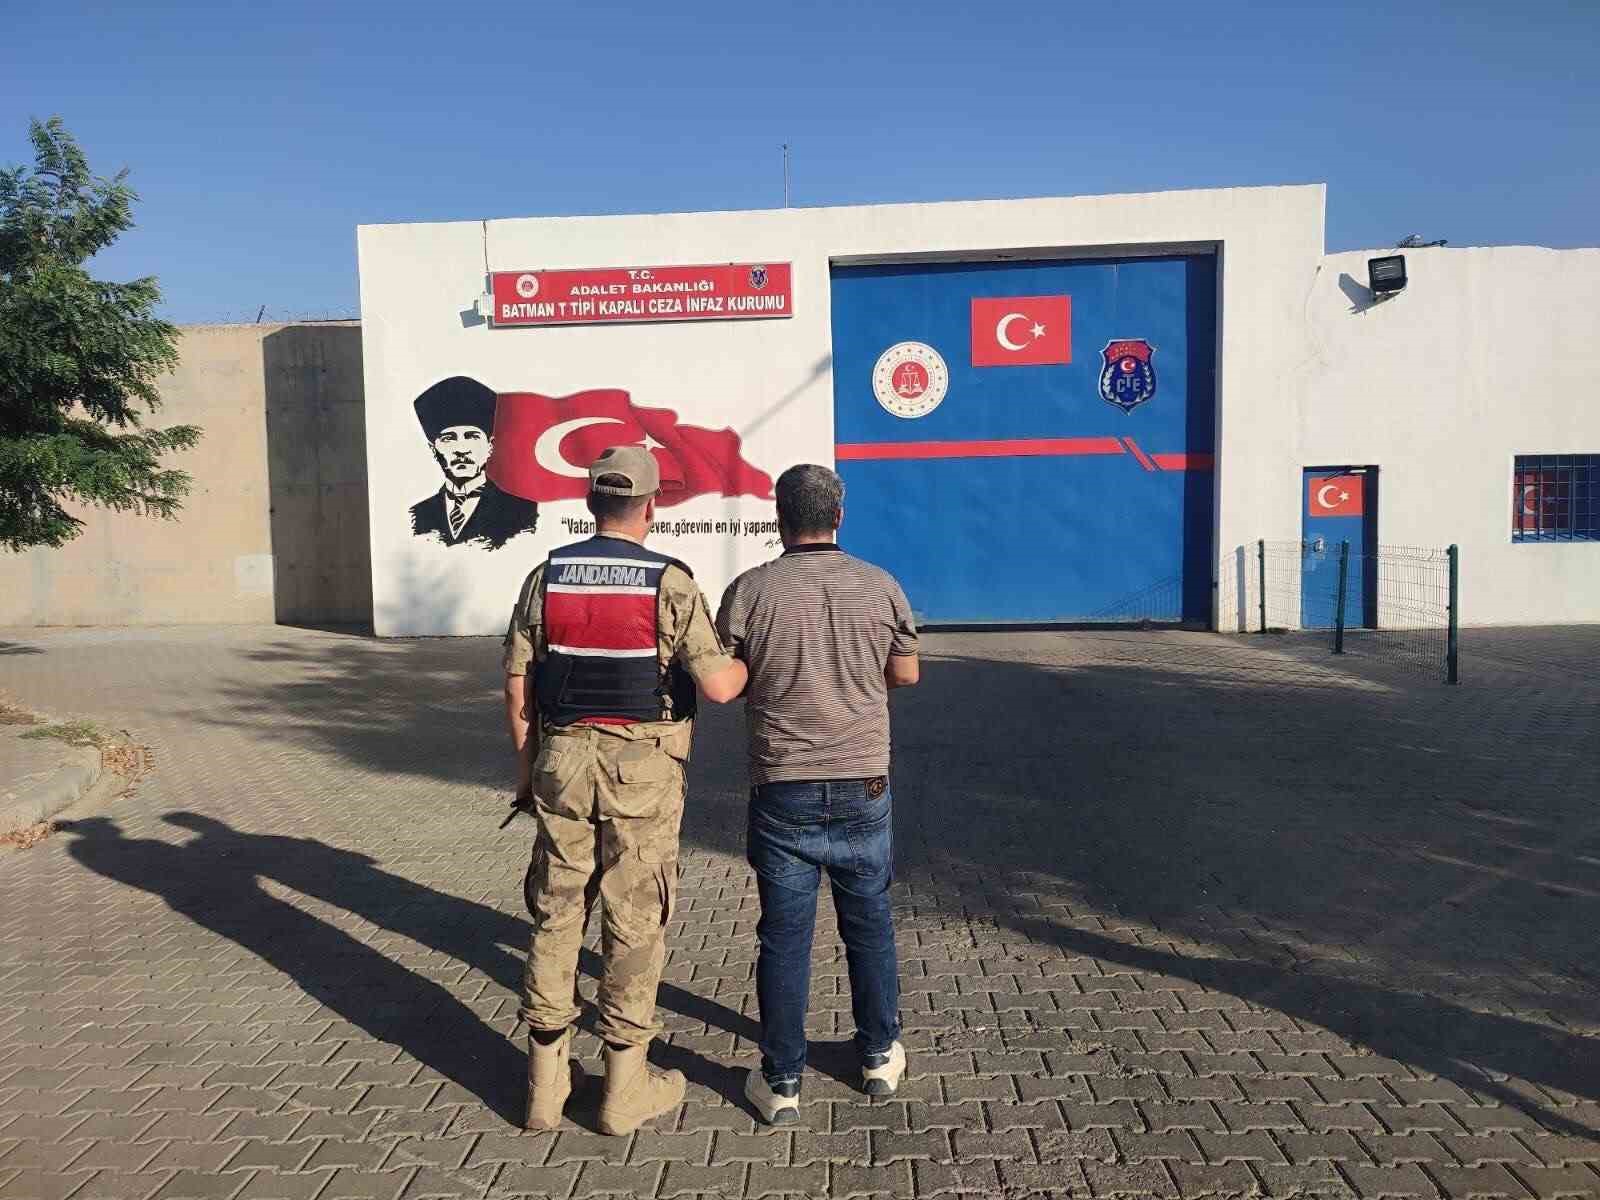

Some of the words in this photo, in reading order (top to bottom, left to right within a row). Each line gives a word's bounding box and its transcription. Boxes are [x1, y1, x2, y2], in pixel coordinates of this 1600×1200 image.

[628, 270, 655, 280] T.C.
[570, 284, 627, 296] ADALET
[632, 280, 714, 294] BAKANLIĞI
[502, 302, 555, 318] BATMAN
[559, 301, 567, 316] T
[570, 297, 595, 316] TİPİ
[599, 298, 645, 315] KAPALI
[648, 298, 683, 313] CEZA
[686, 294, 724, 312] İNFAZ
[727, 294, 785, 312] KURUMU
[1117, 374, 1141, 393] CTE
[715, 521, 727, 534] en
[730, 518, 741, 537] iyi
[558, 564, 646, 586] JANDARMA
